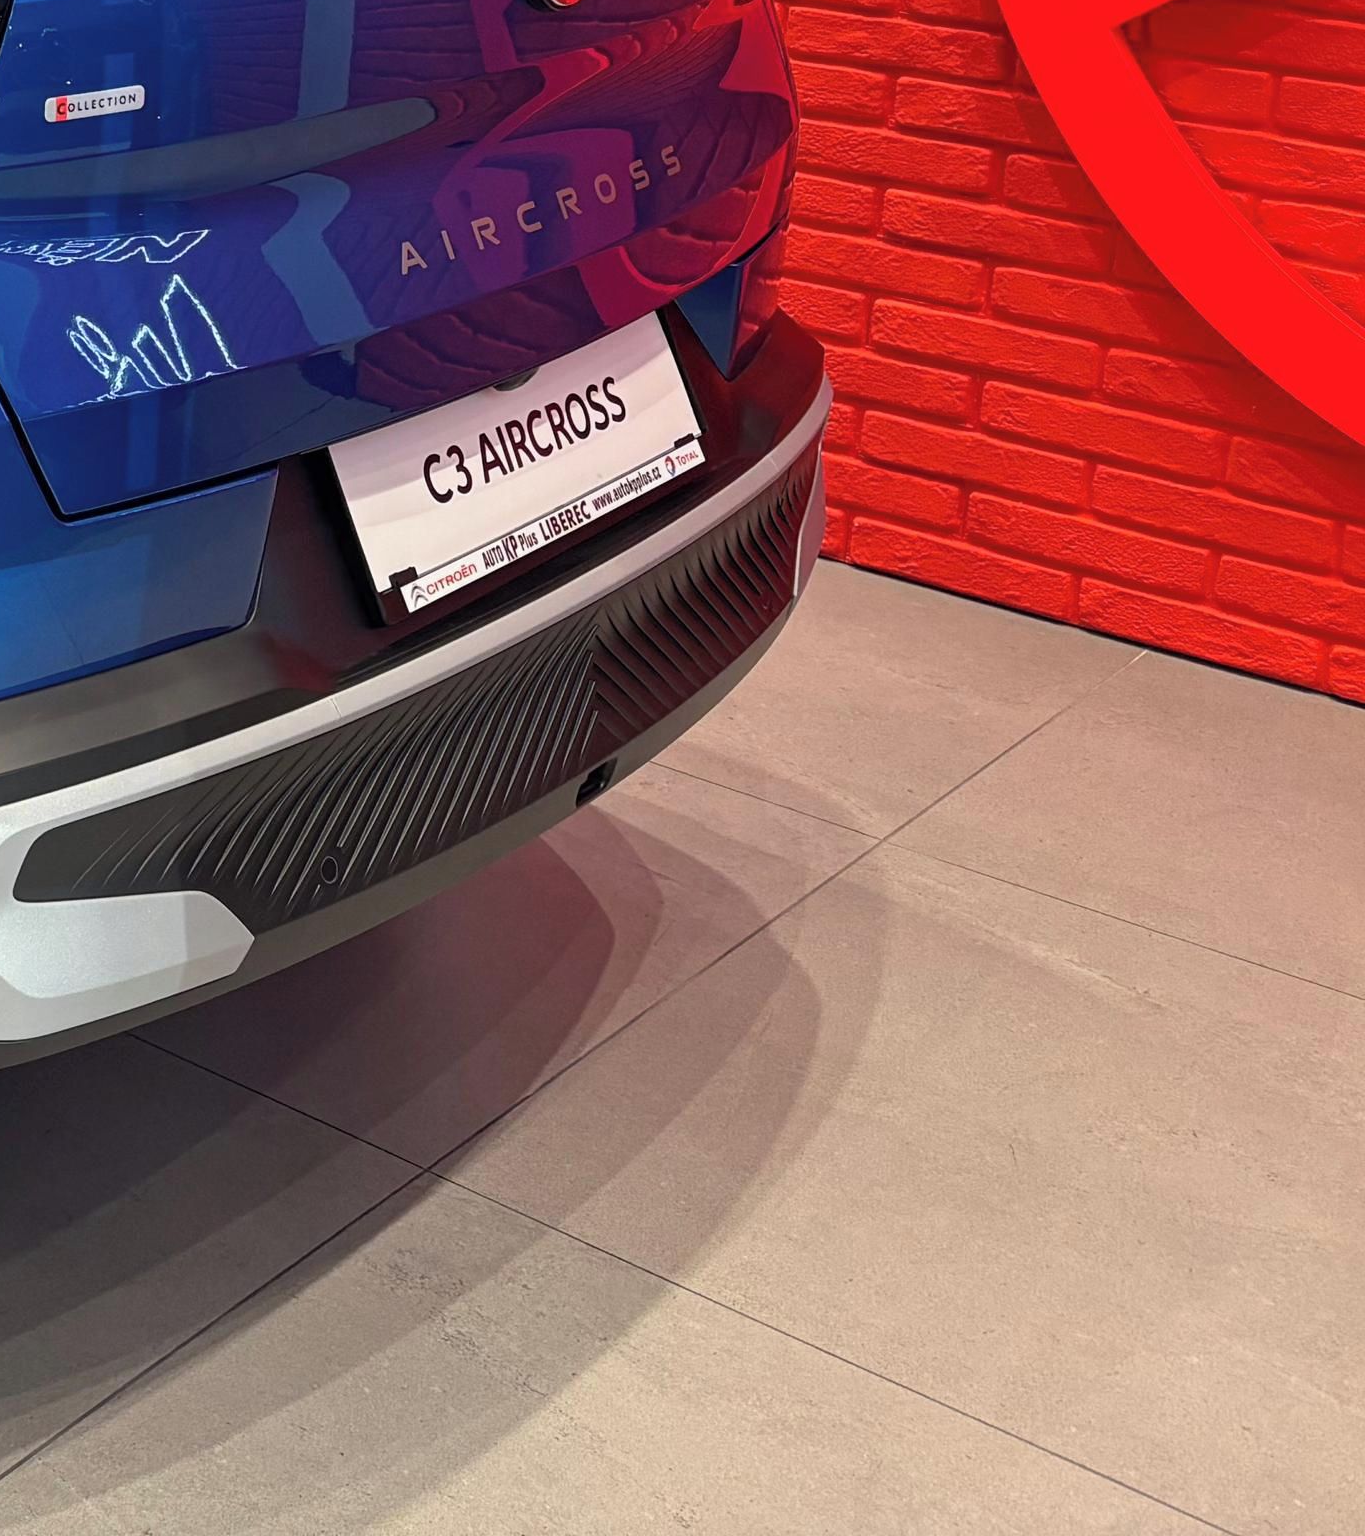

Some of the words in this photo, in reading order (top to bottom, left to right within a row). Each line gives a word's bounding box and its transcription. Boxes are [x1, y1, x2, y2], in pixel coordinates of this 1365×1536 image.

[56, 92, 137, 116] COLLECTION
[400, 144, 682, 276] AIRCROSS
[423, 444, 474, 504] C3
[478, 376, 627, 483] AIRCROSS
[518, 531, 539, 552] Plus
[538, 500, 592, 542] LIBEREC
[591, 466, 662, 511] www.autokpplus.cz
